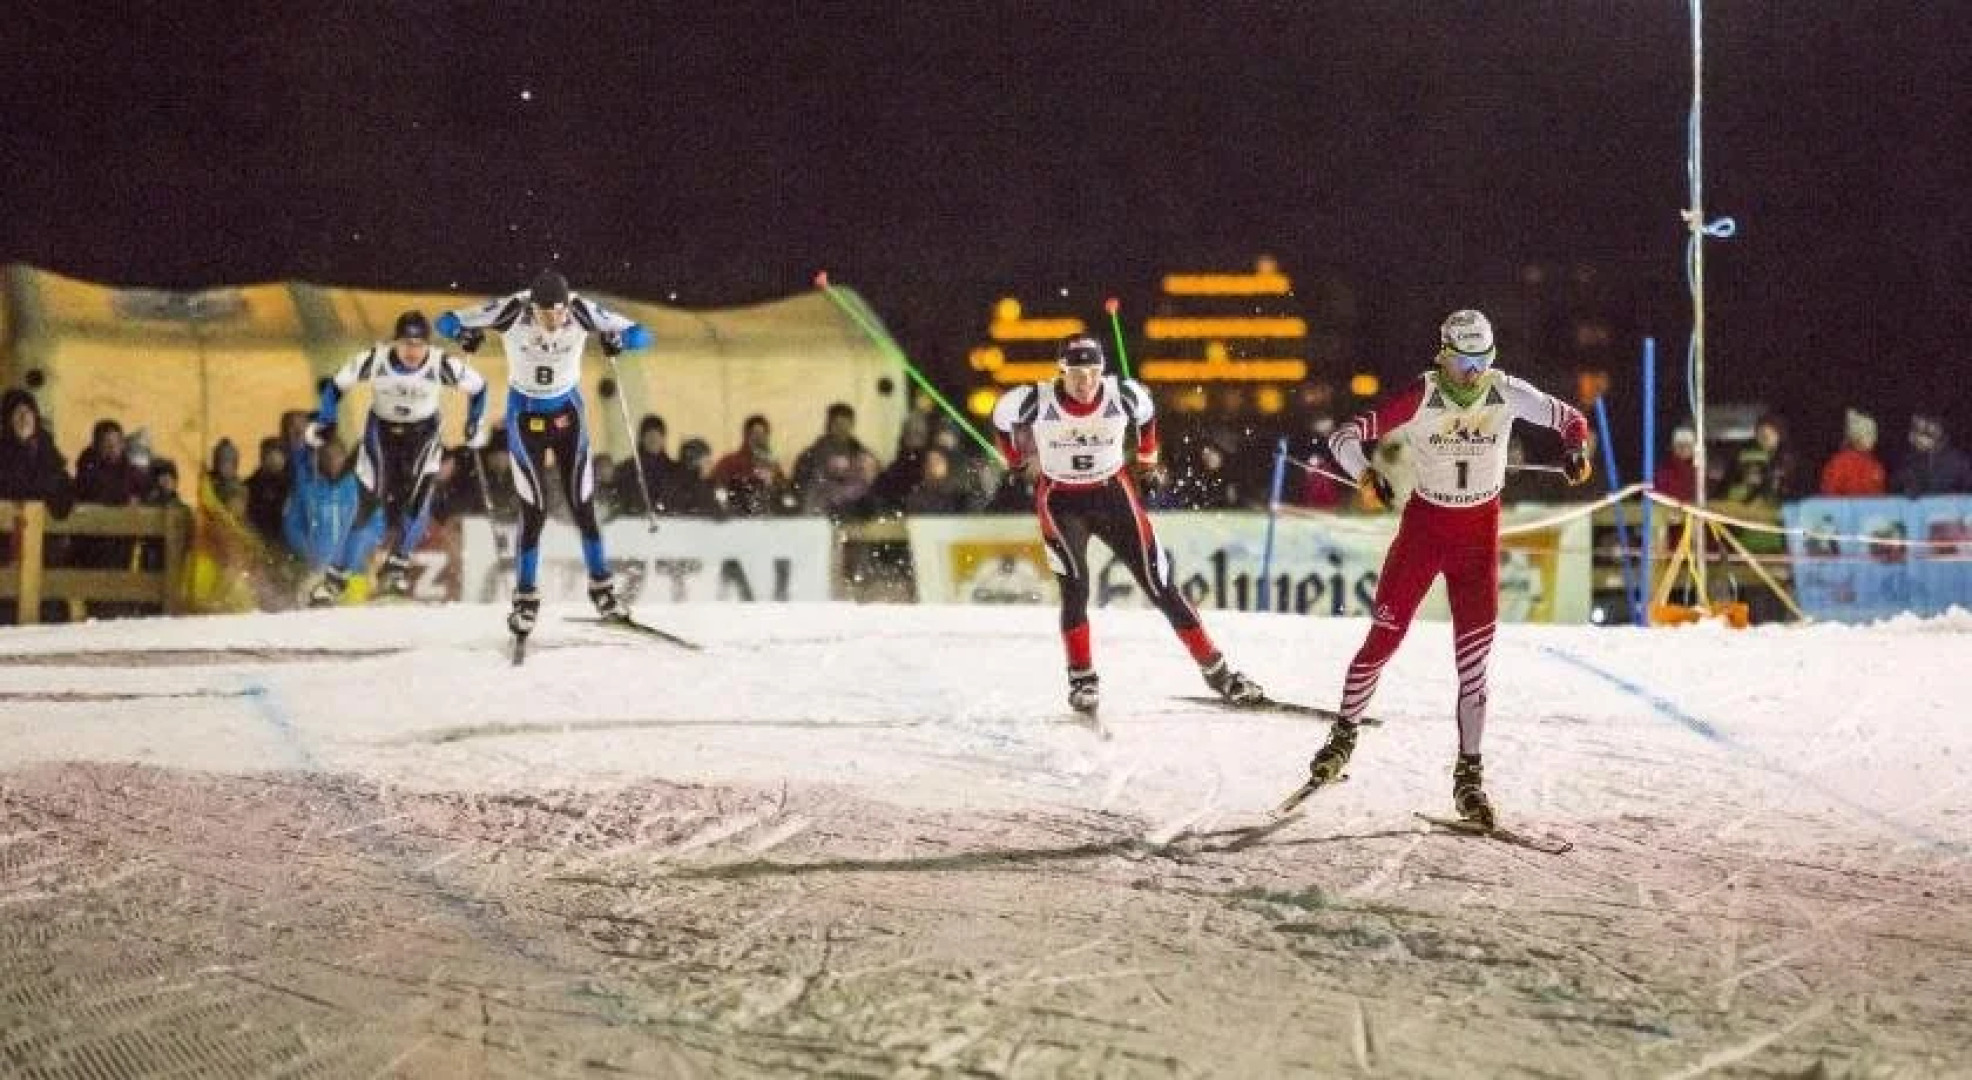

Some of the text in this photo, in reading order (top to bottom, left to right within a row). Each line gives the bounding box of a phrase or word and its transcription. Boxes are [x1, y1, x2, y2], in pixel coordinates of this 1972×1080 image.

[536, 366, 554, 385] 8
[1071, 455, 1095, 470] 6
[1455, 461, 1468, 489] 1
